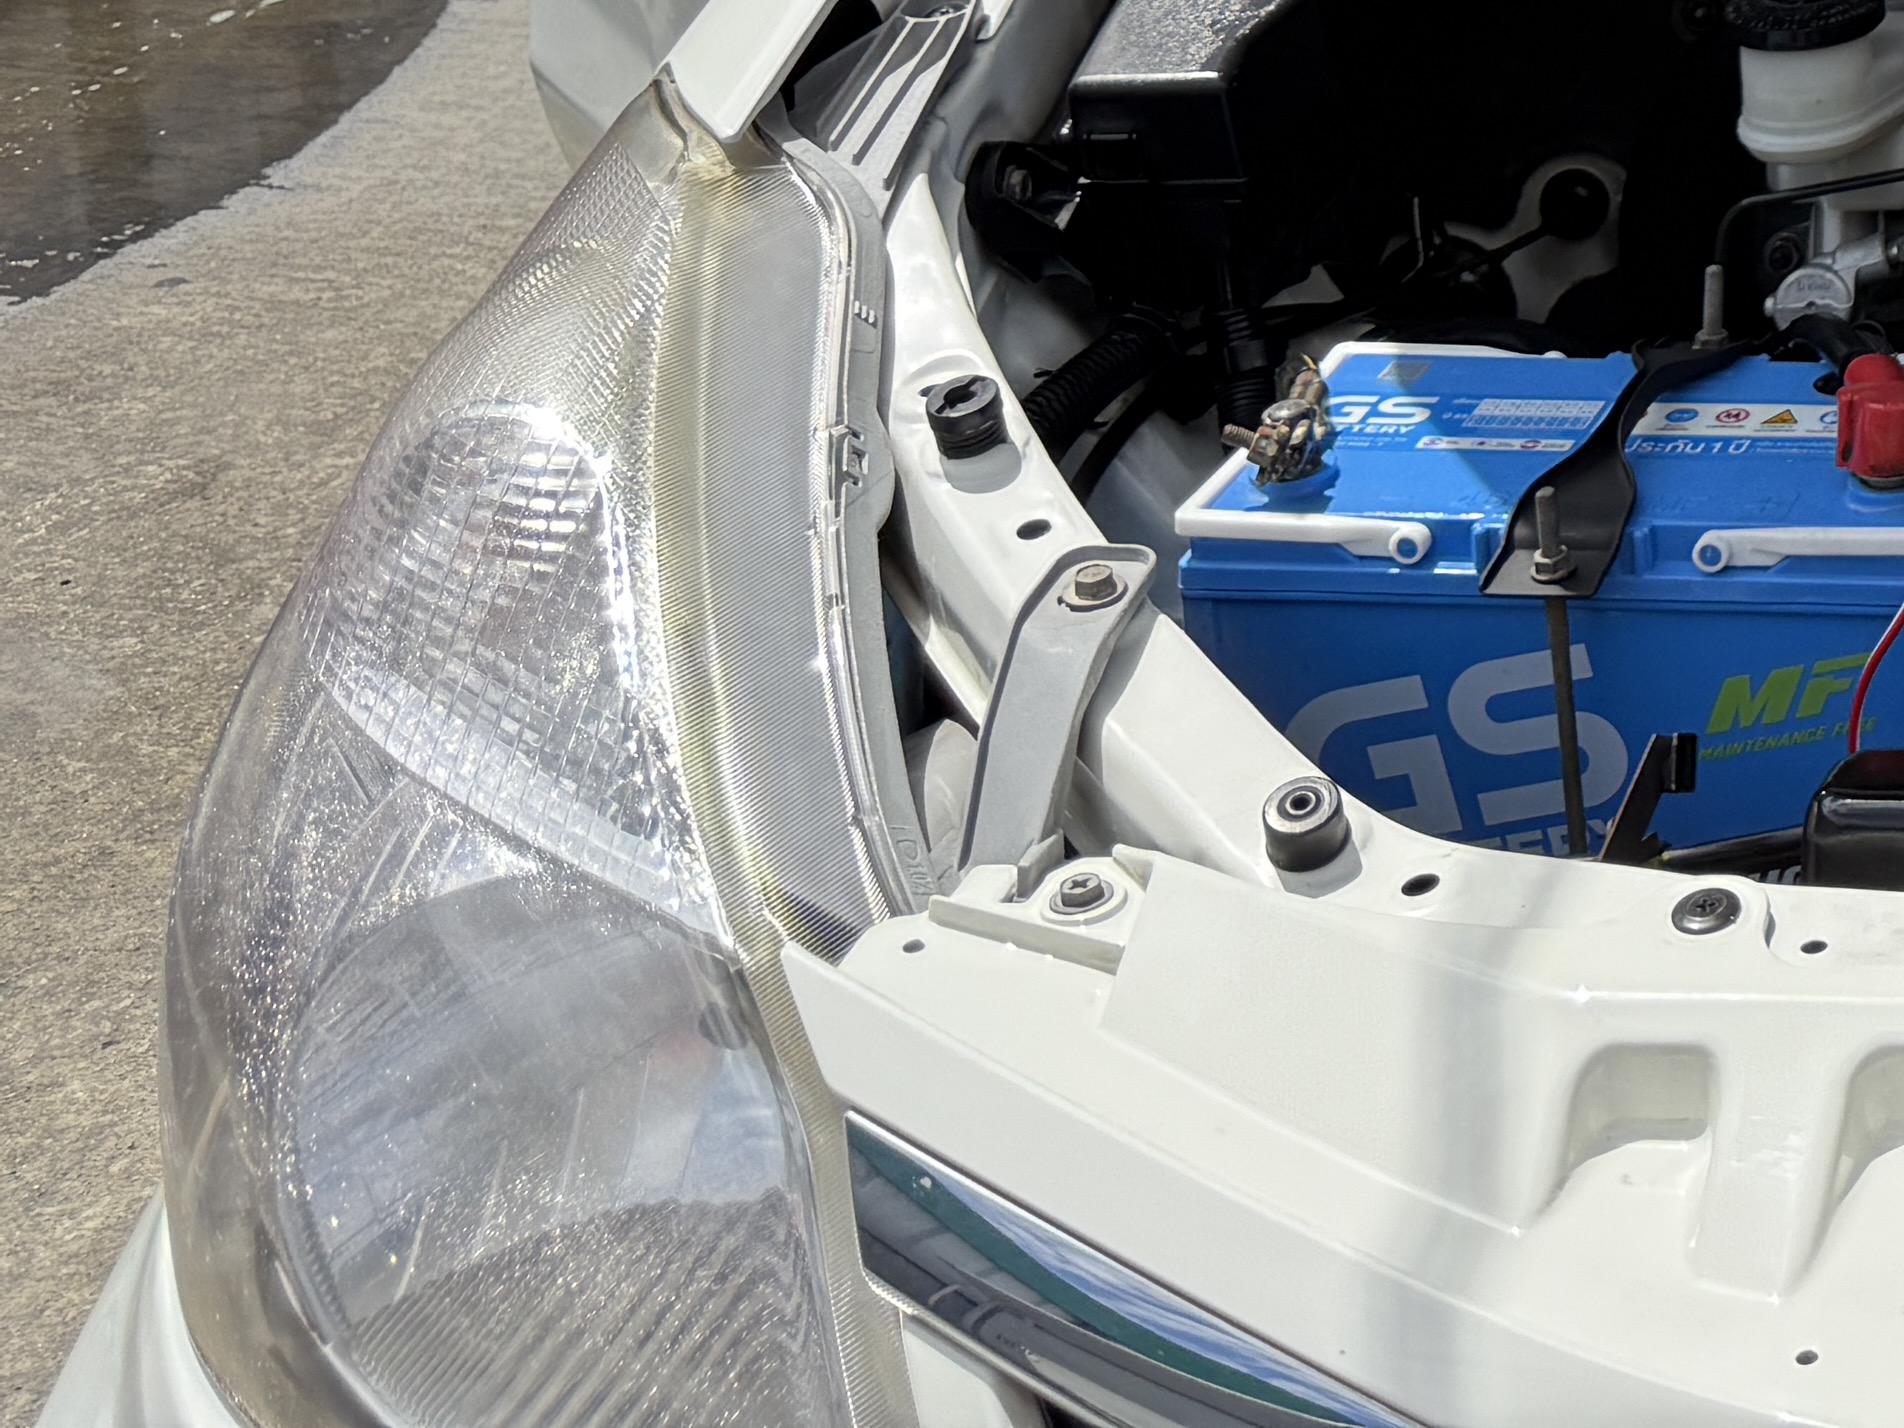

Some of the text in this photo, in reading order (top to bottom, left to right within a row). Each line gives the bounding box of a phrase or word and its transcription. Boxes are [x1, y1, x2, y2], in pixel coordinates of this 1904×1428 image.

[1329, 394, 1441, 425] GS
[1333, 424, 1416, 434] TTERY
[1706, 652, 1871, 734] MF
[1285, 643, 1629, 834] GS
[1698, 727, 1826, 761] MAINTENANCE
